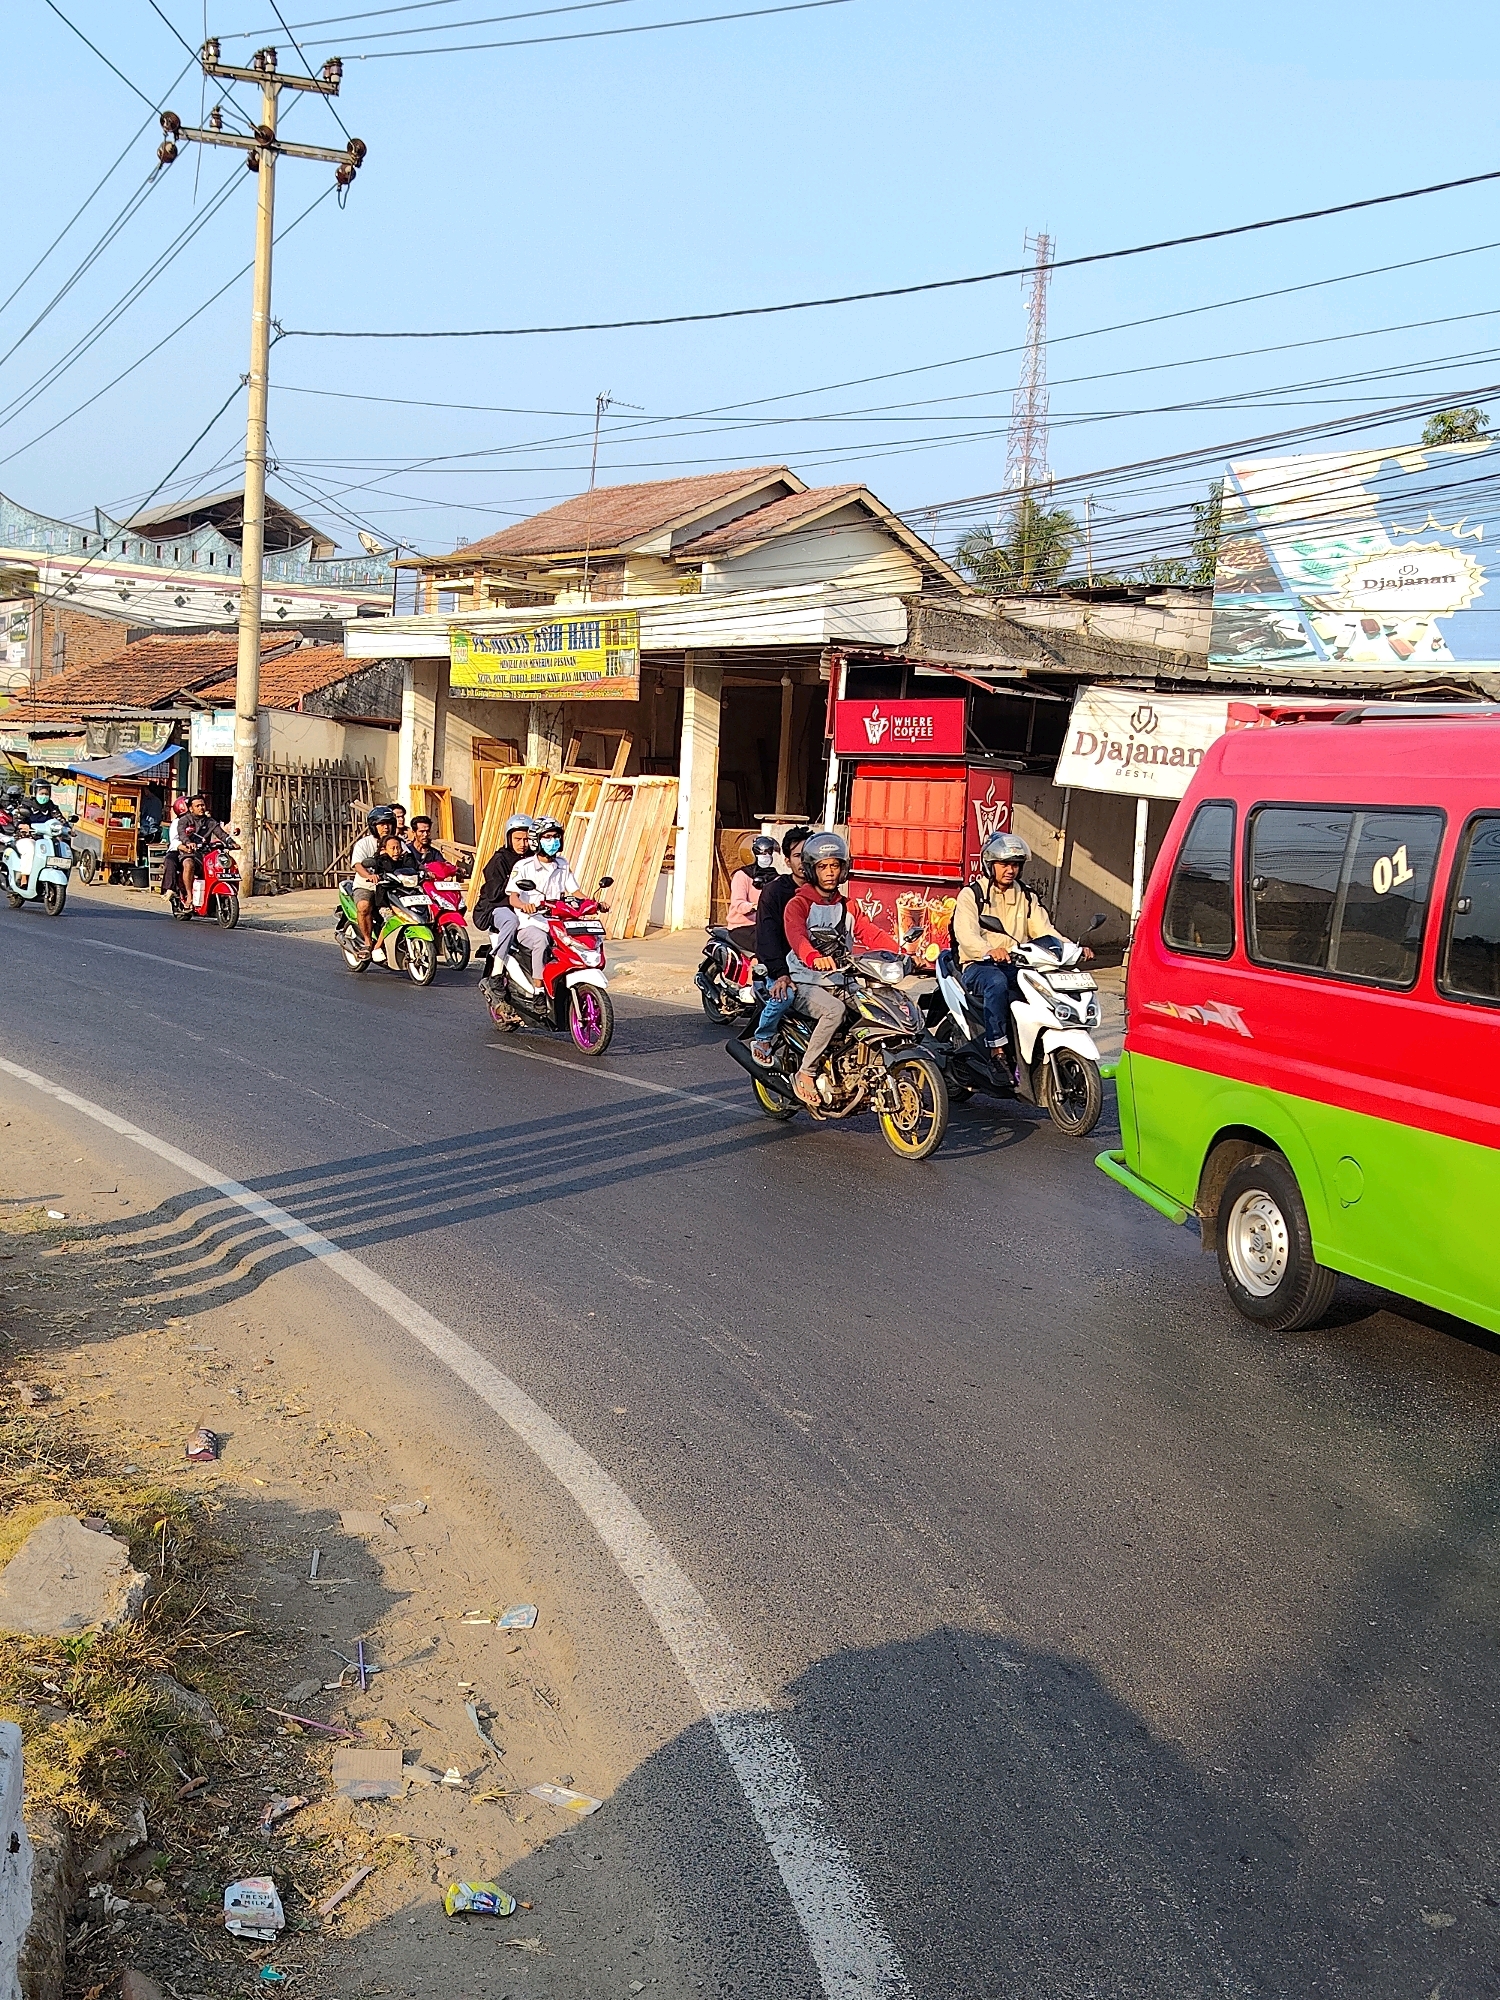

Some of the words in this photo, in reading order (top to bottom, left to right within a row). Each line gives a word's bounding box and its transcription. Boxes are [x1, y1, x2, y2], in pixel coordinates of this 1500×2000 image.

[1362, 574, 1457, 592] Djajanan
[567, 621, 601, 650] HATI
[893, 716, 933, 727] WHERE
[893, 727, 934, 737] COFFEE
[1071, 731, 1206, 768] Djajanan
[1115, 768, 1154, 780] BESTI
[1372, 844, 1414, 895] 01
